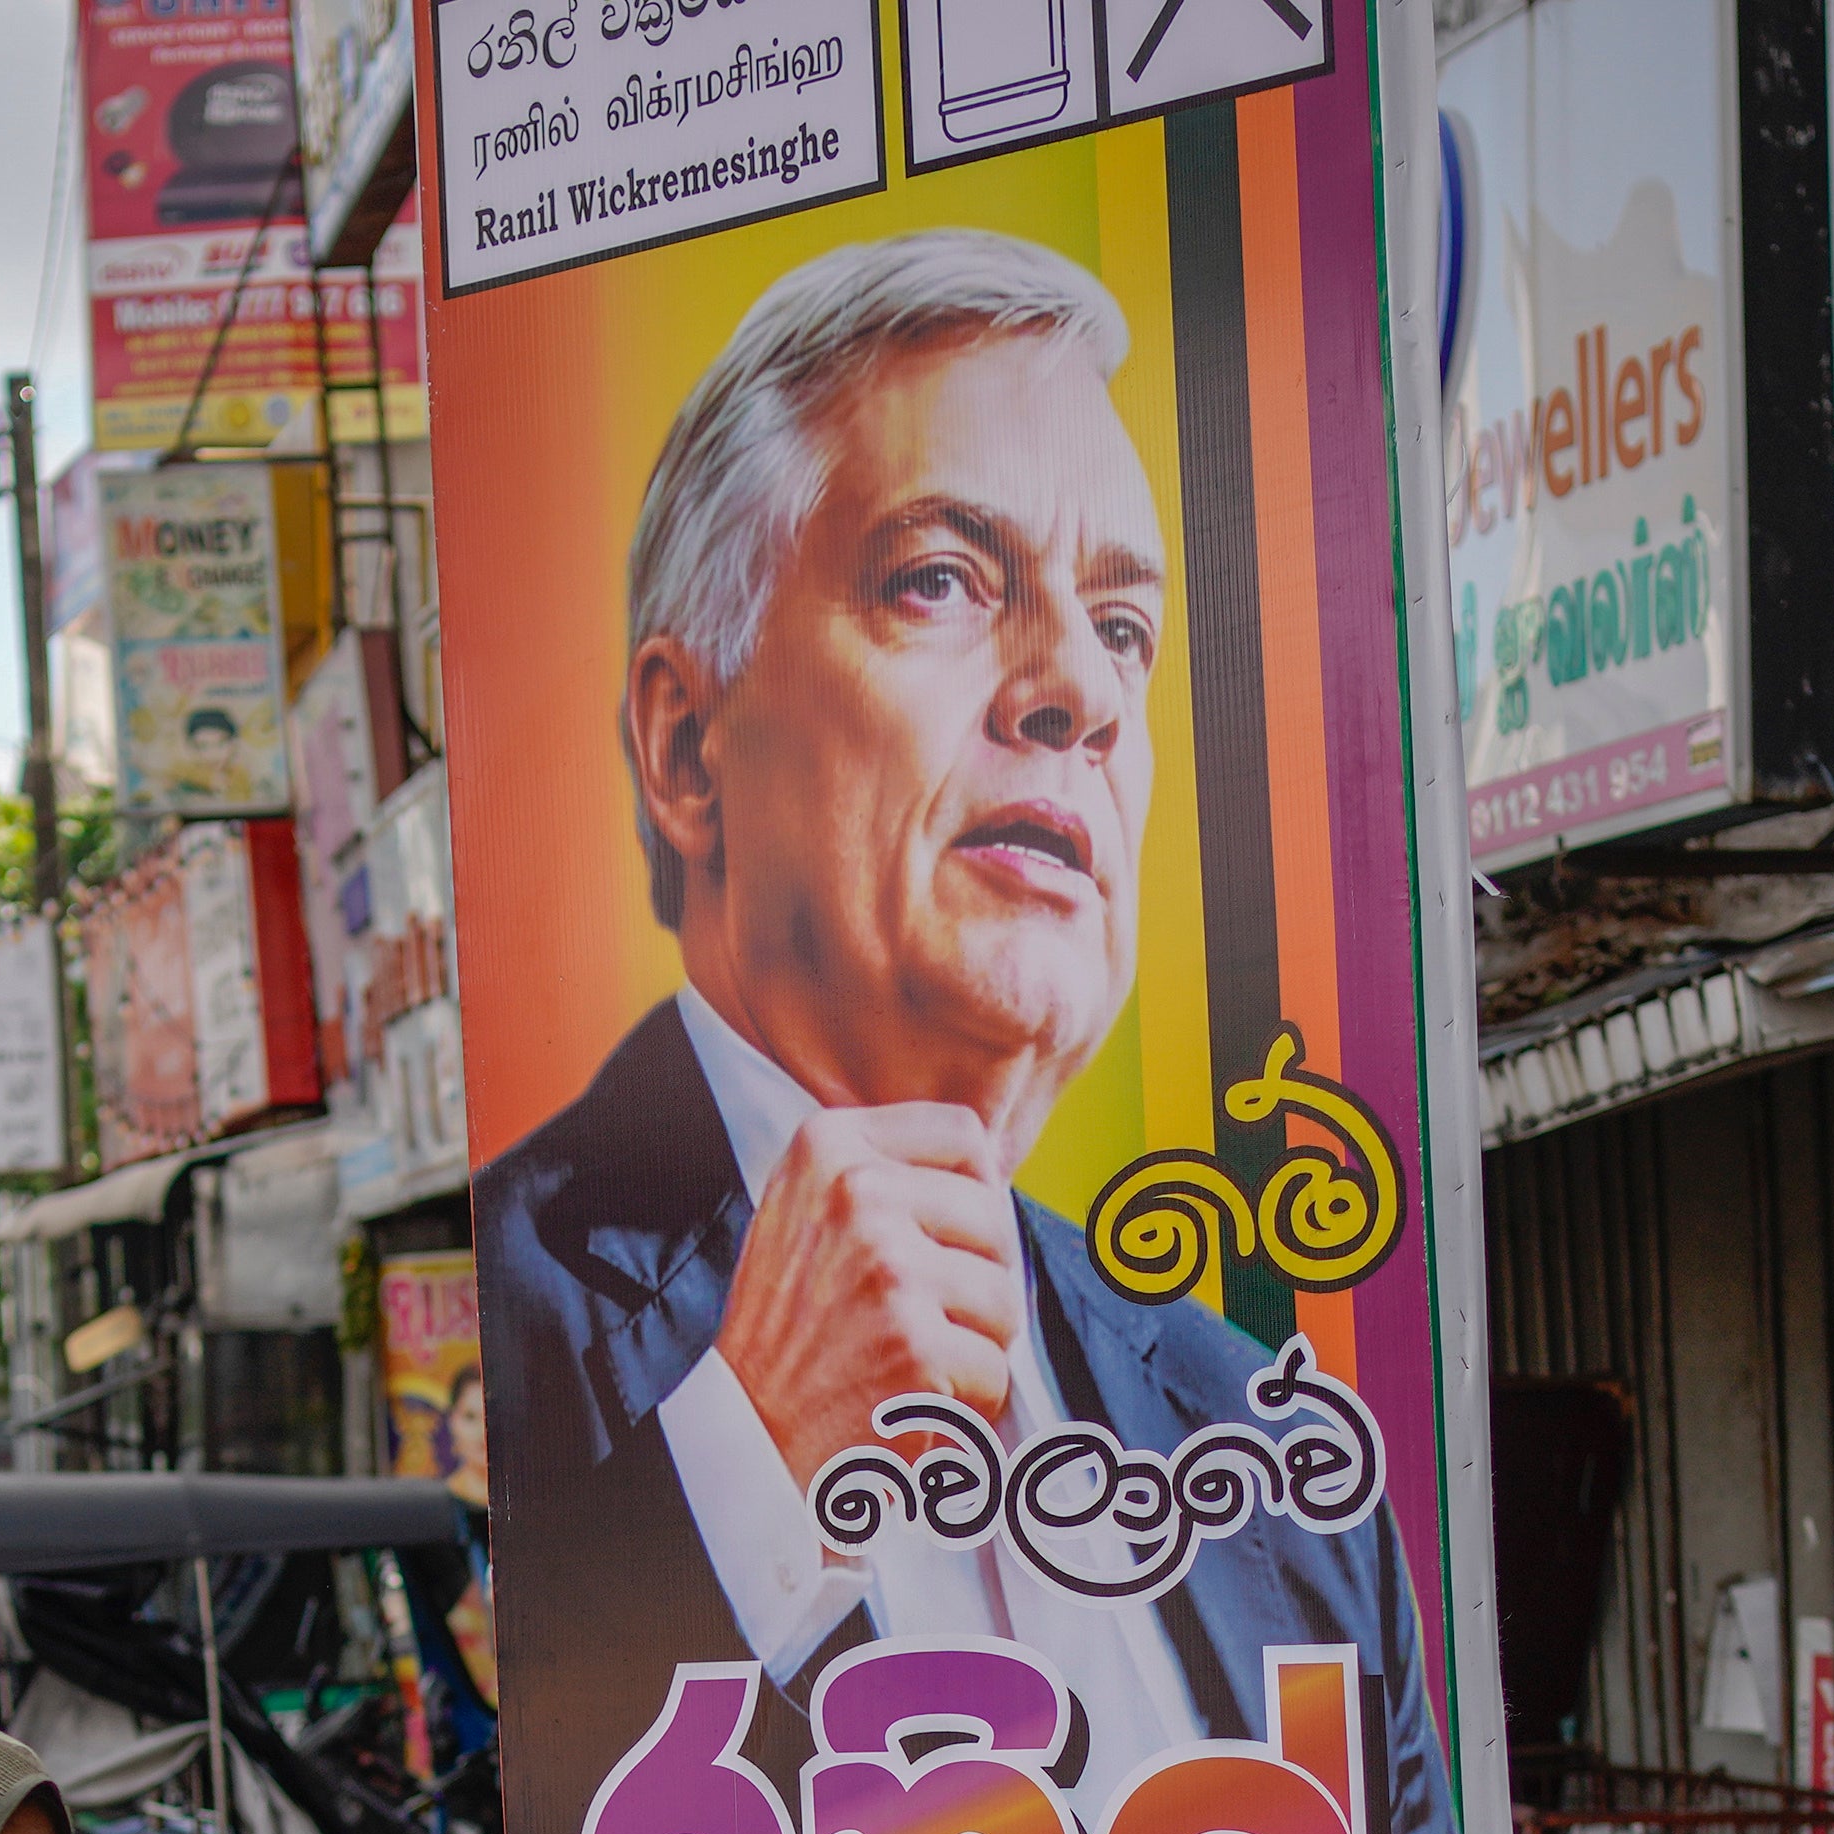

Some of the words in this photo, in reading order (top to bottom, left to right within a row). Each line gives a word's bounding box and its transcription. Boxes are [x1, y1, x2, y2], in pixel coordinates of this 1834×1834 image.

[473, 95, 580, 182] ரணில்
[606, 34, 844, 131] விக்ரமசிங்ஹ
[474, 188, 559, 252] Ranil
[567, 120, 841, 227] Wickremesinghe
[115, 515, 259, 561] MONEY
[1545, 764, 1601, 819] 431
[1607, 743, 1669, 803] 954
[1087, 1022, 1404, 1304] මේ
[811, 1340, 1381, 1602] වෙලාවේ
